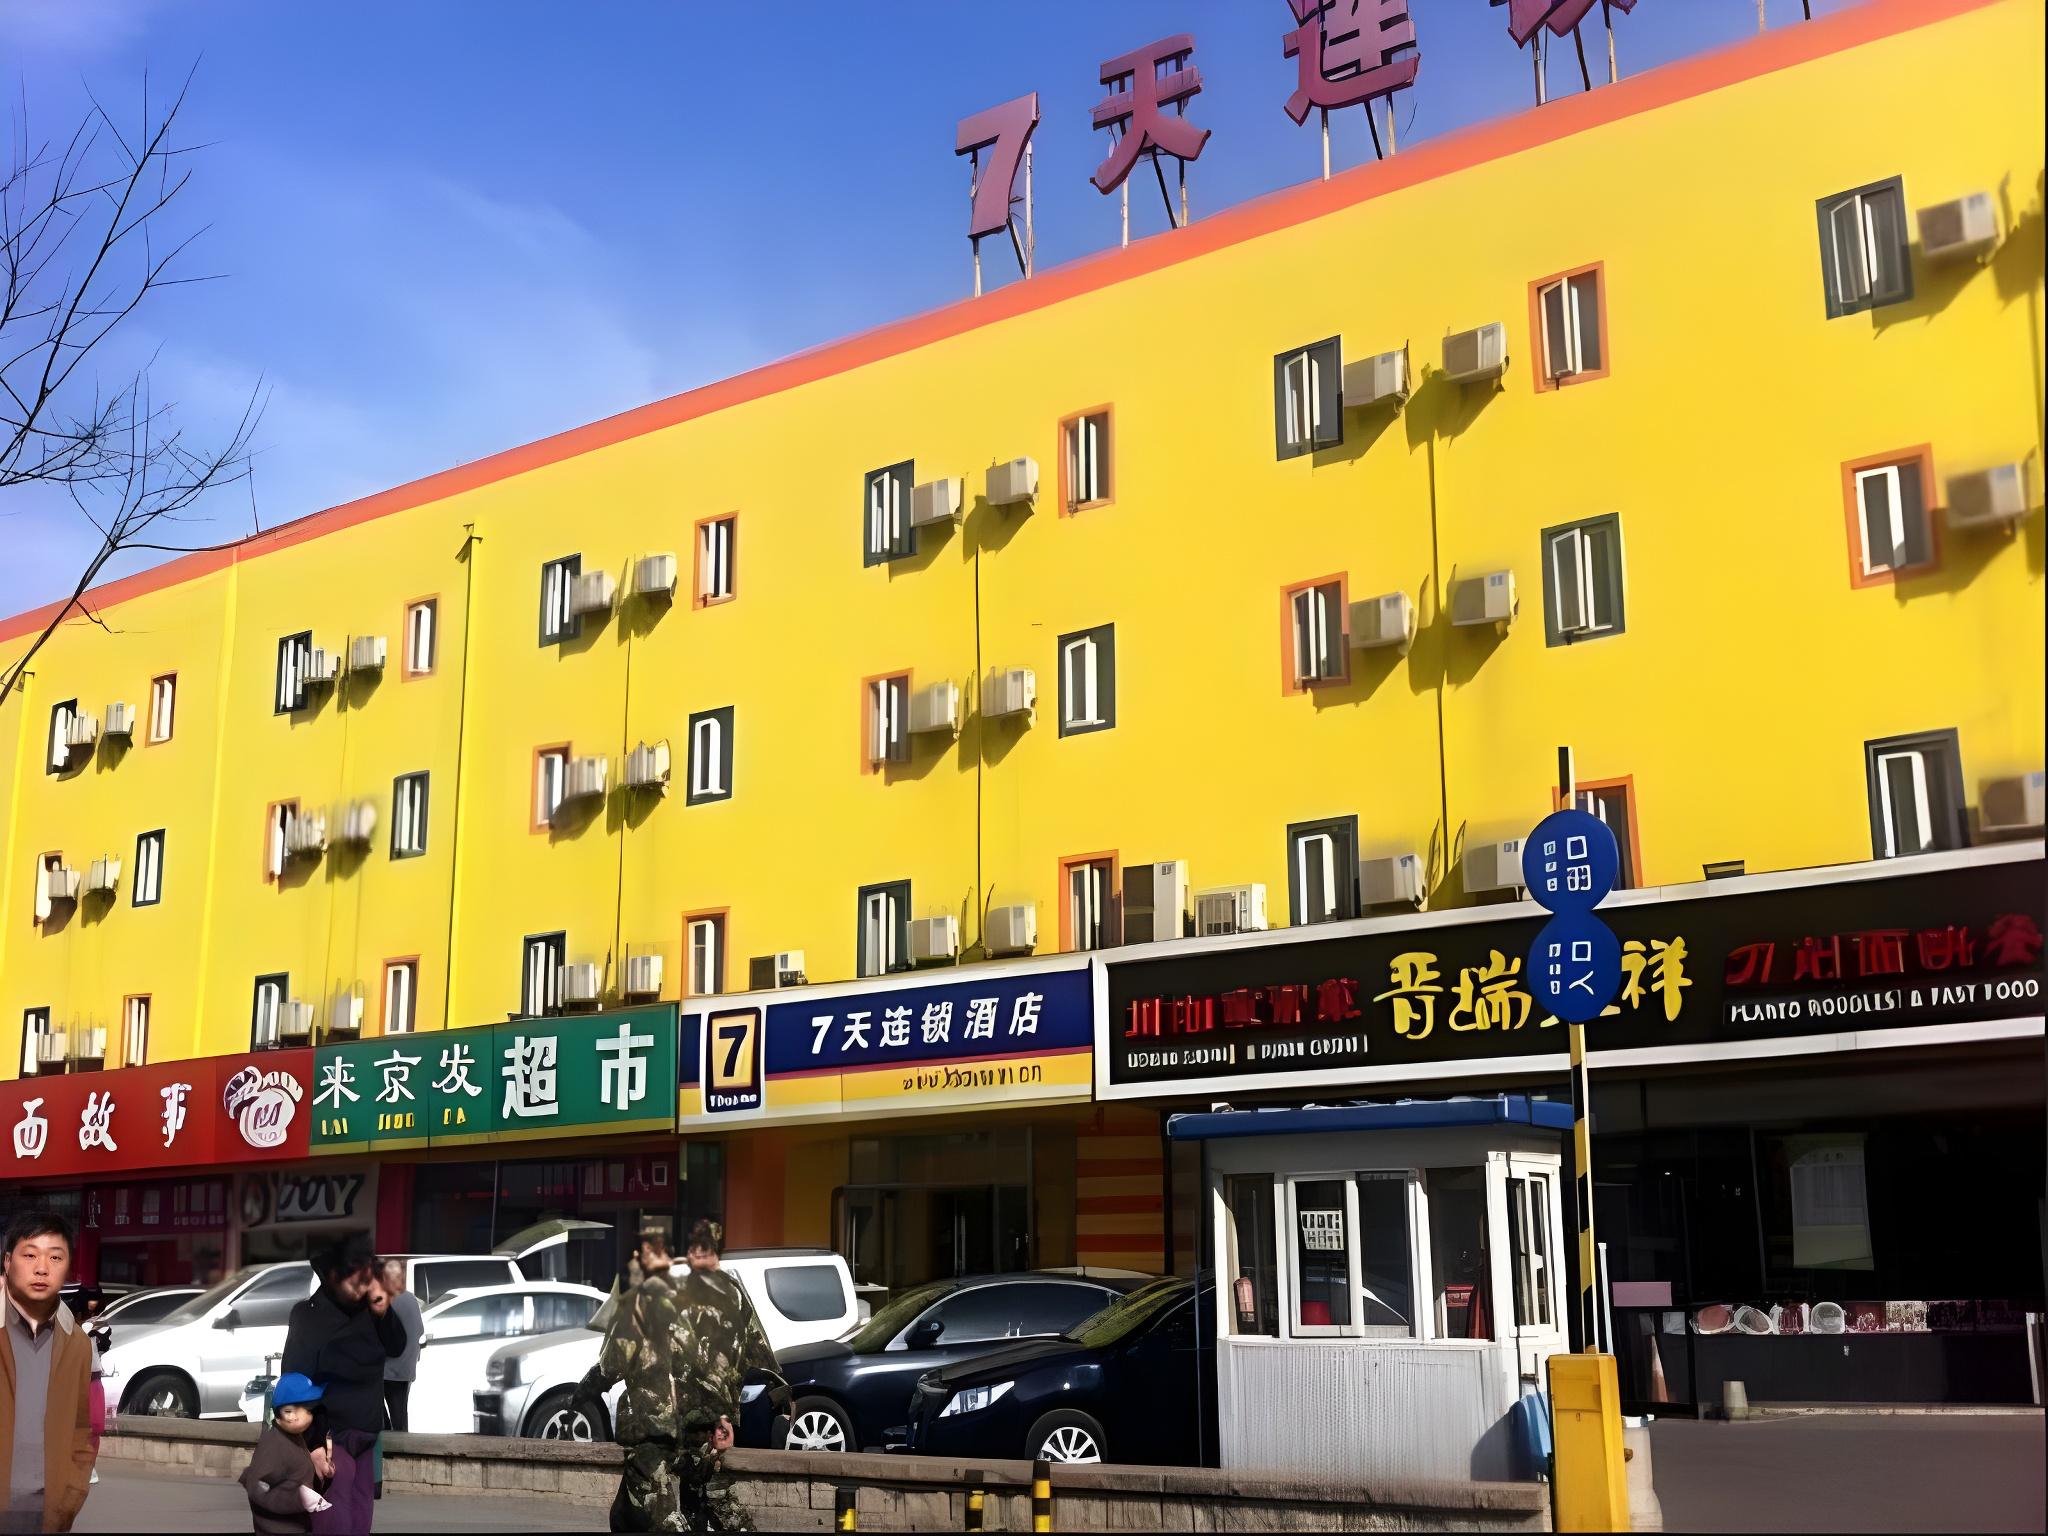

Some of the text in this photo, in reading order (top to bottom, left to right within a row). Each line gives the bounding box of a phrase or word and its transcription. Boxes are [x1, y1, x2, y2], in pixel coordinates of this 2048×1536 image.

[955, 0, 1634, 238] 7天连
[811, 992, 1044, 1055] 7天连锁酒店
[1373, 936, 1693, 1040] 晋瑞祥
[718, 1024, 748, 1078] 7
